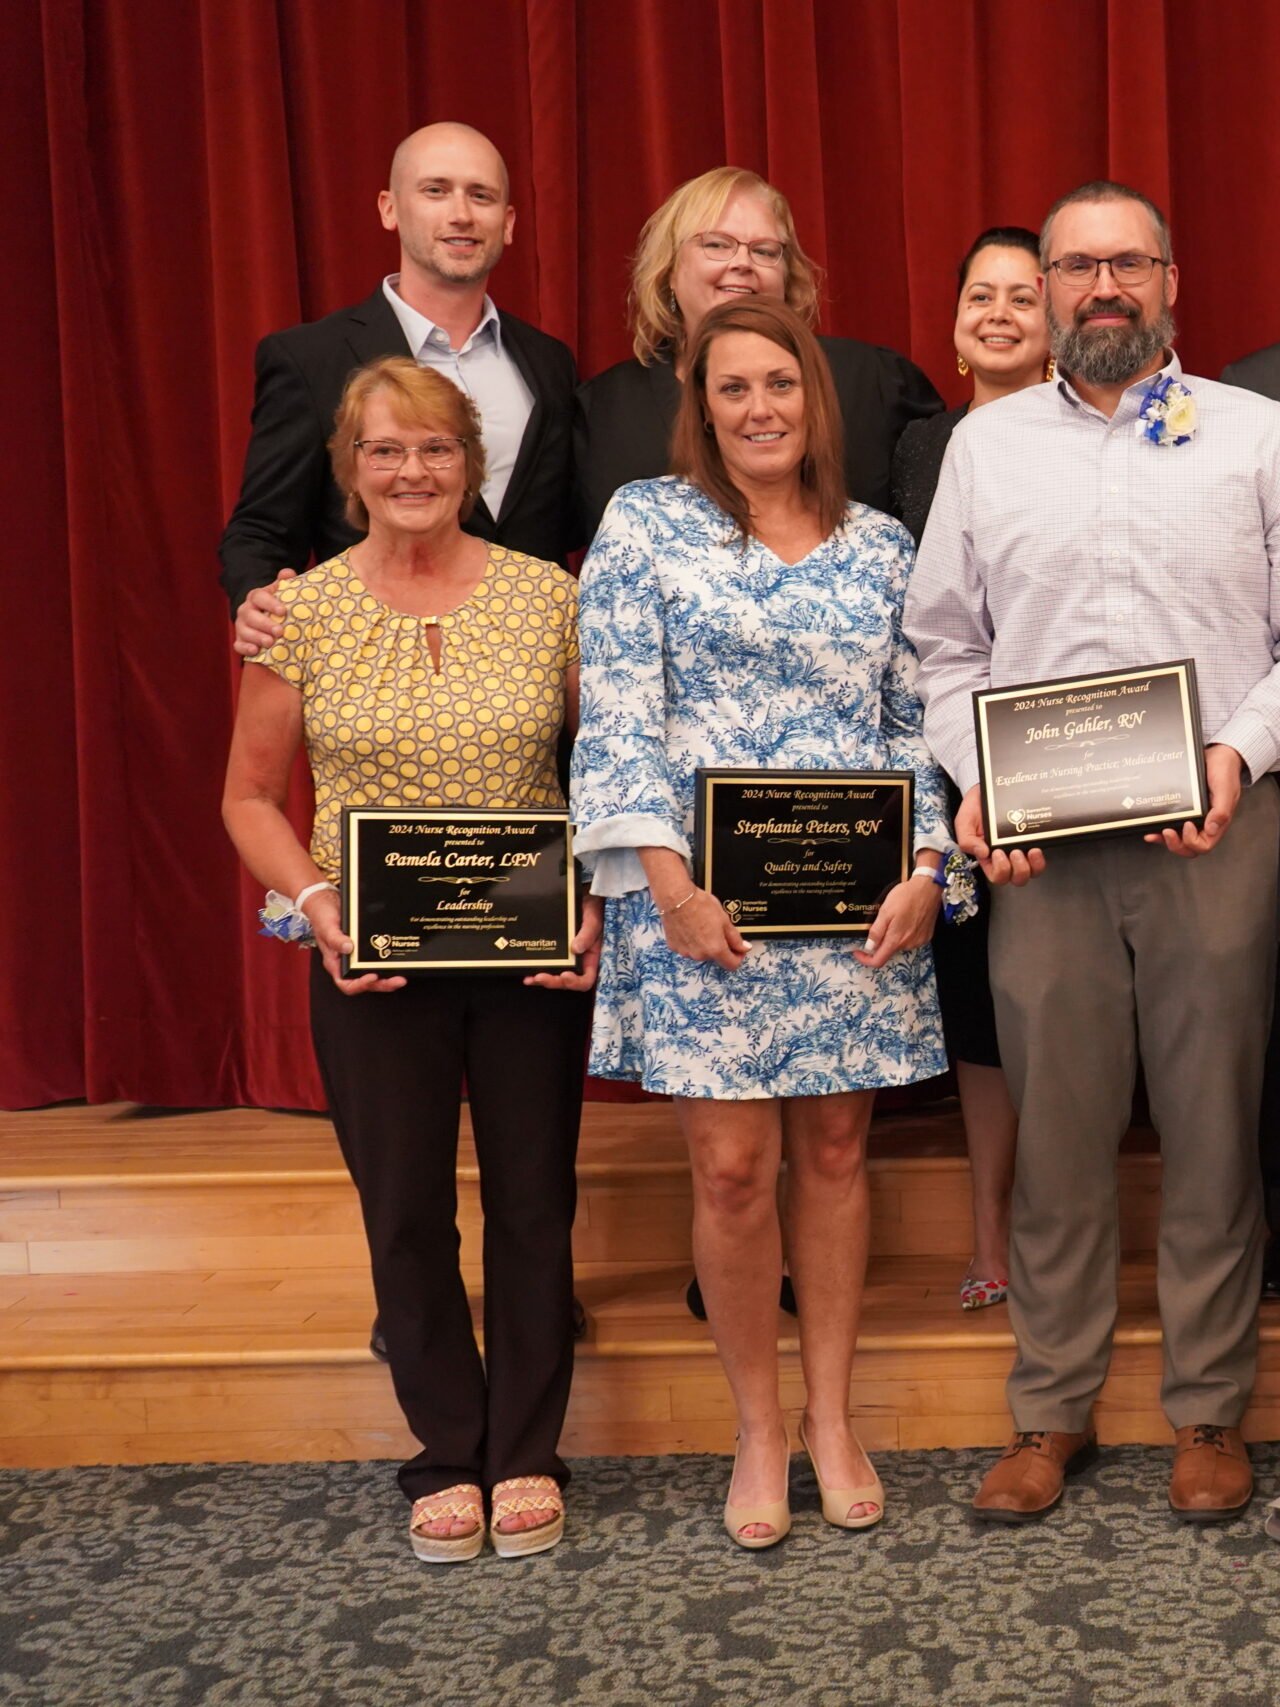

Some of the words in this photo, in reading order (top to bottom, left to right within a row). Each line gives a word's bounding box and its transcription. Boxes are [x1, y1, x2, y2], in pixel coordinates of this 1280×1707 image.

[1013, 701, 1035, 712] 2024
[1038, 698, 1063, 709] Nurse
[1066, 690, 1117, 704] Recognition
[1118, 681, 1151, 696] Award
[1065, 705, 1094, 716] presented
[1025, 724, 1060, 744] John
[1064, 715, 1113, 740] Gahler,
[1118, 711, 1146, 729] RN
[1083, 752, 1094, 760] for
[996, 770, 1038, 787] Excellence
[1040, 769, 1048, 778] in
[1050, 763, 1083, 778] Nursing
[1085, 759, 1120, 773] Practice;
[1122, 754, 1155, 768] Medical
[1157, 750, 1184, 763] Center
[742, 790, 763, 798] 2024
[765, 790, 791, 799] Nurse
[793, 790, 843, 801] Recognition
[844, 789, 876, 799] Award
[1136, 793, 1181, 805] Samaritan
[792, 803, 821, 812] presented
[389, 825, 412, 834] 2024
[415, 825, 443, 834] Nurse
[445, 825, 501, 836] Recognition
[502, 825, 537, 835] Award
[734, 818, 802, 838] Stephanie
[806, 820, 850, 835] Peters,
[855, 820, 882, 835] RN
[444, 838, 476, 847] presented
[385, 851, 441, 867] Pamela
[445, 853, 495, 868] Carter,
[499, 853, 541, 867] LPN
[804, 850, 814, 858] for
[764, 862, 800, 874] Quality
[802, 862, 819, 871] and
[822, 862, 852, 874] Safety
[458, 888, 470, 897] for
[437, 900, 493, 912] Leadership
[509, 939, 557, 947] Samaritan
